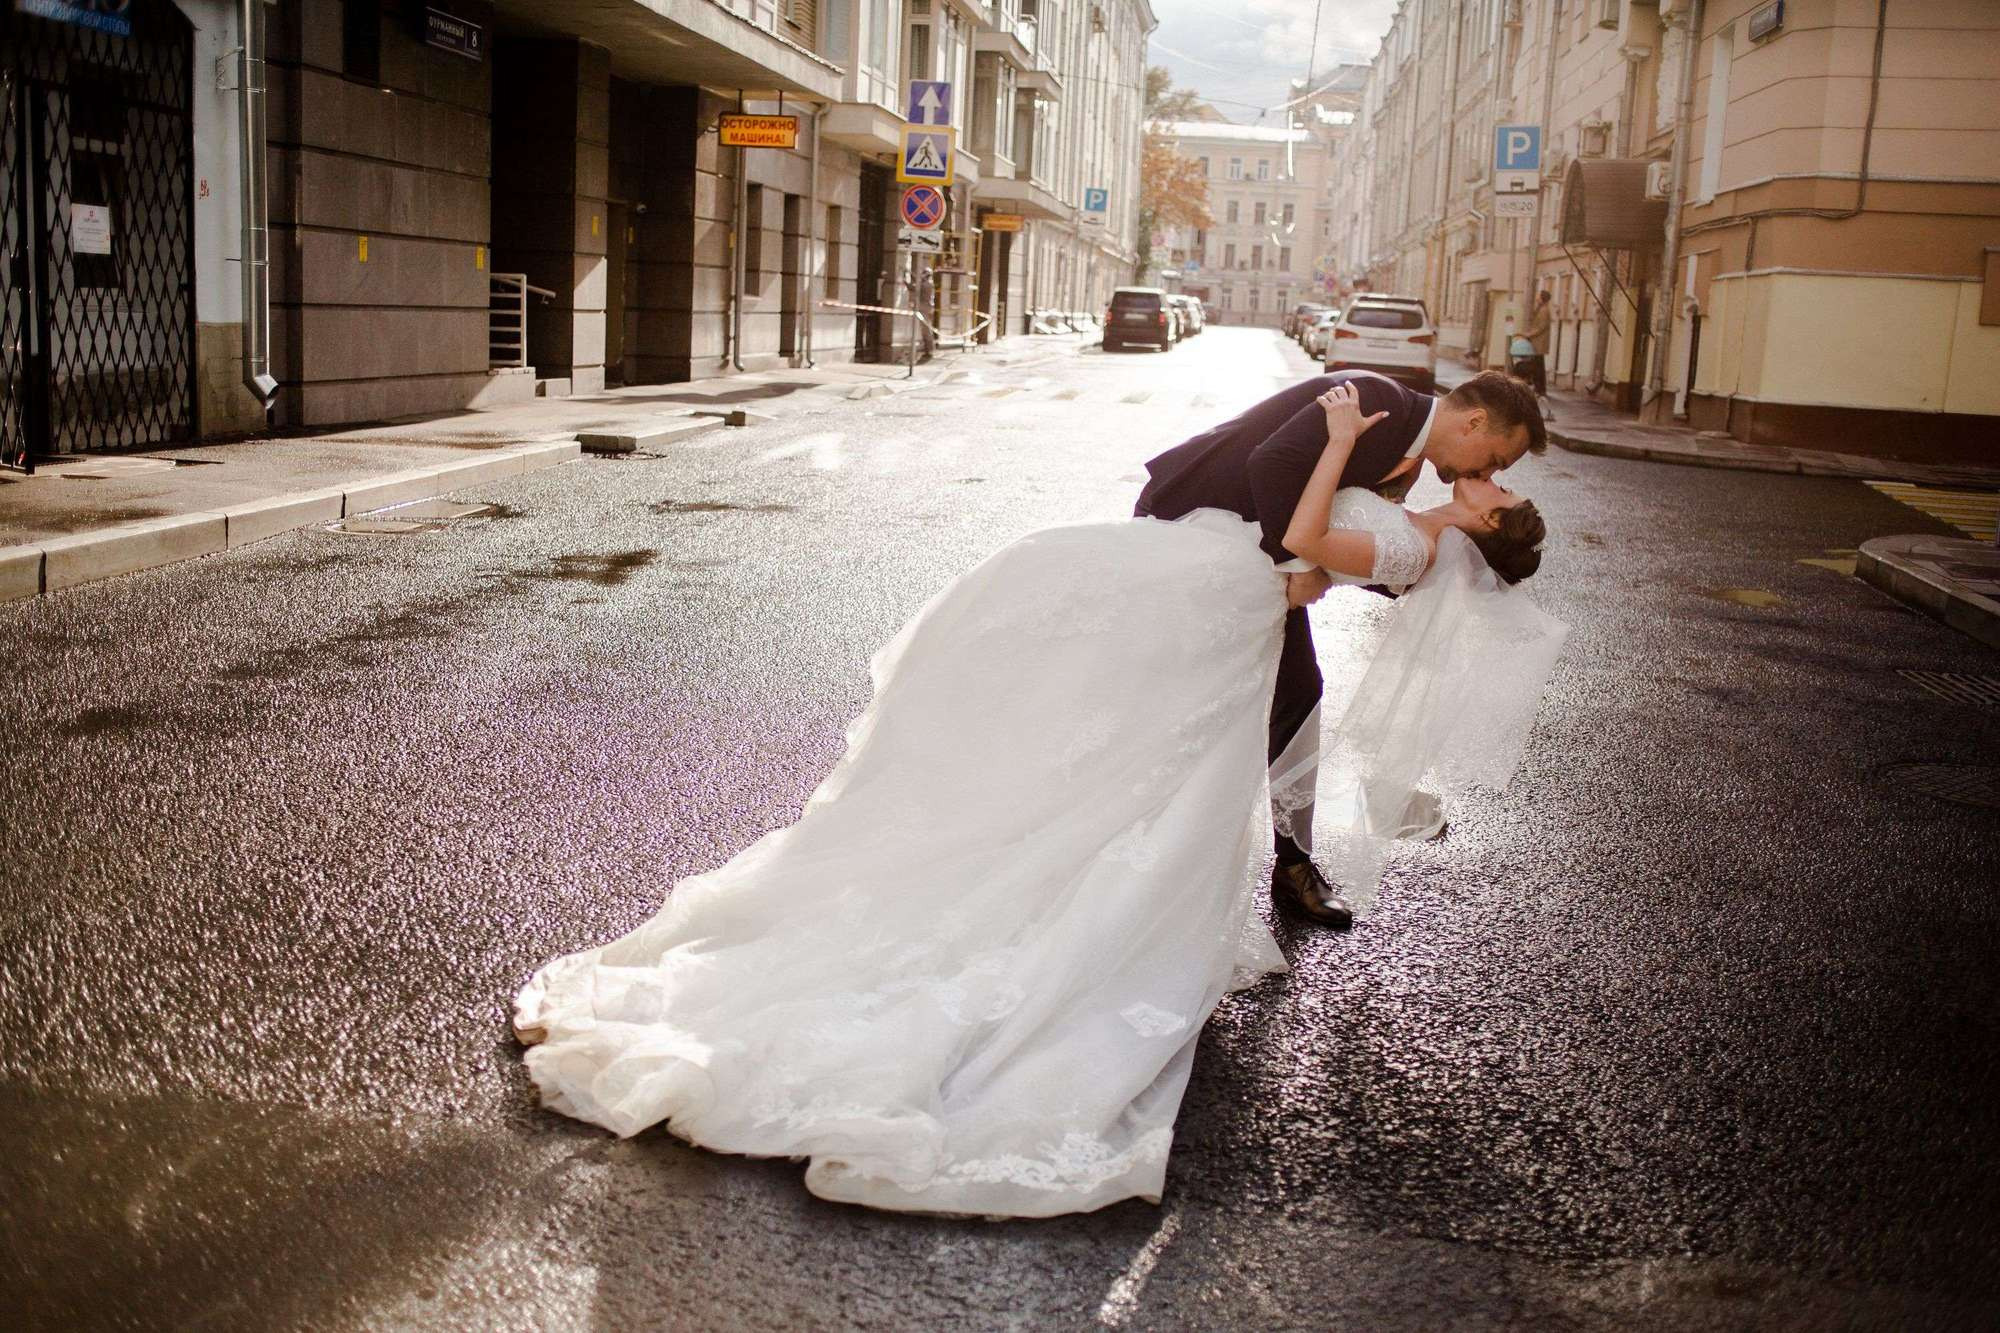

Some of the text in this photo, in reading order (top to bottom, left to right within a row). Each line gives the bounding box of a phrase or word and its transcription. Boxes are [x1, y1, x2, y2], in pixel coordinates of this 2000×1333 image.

[472, 31, 478, 48] 8
[721, 118, 795, 130] ОСТОРОЖНО
[730, 132, 786, 144] МАШИНА!
[1507, 131, 1532, 165] P
